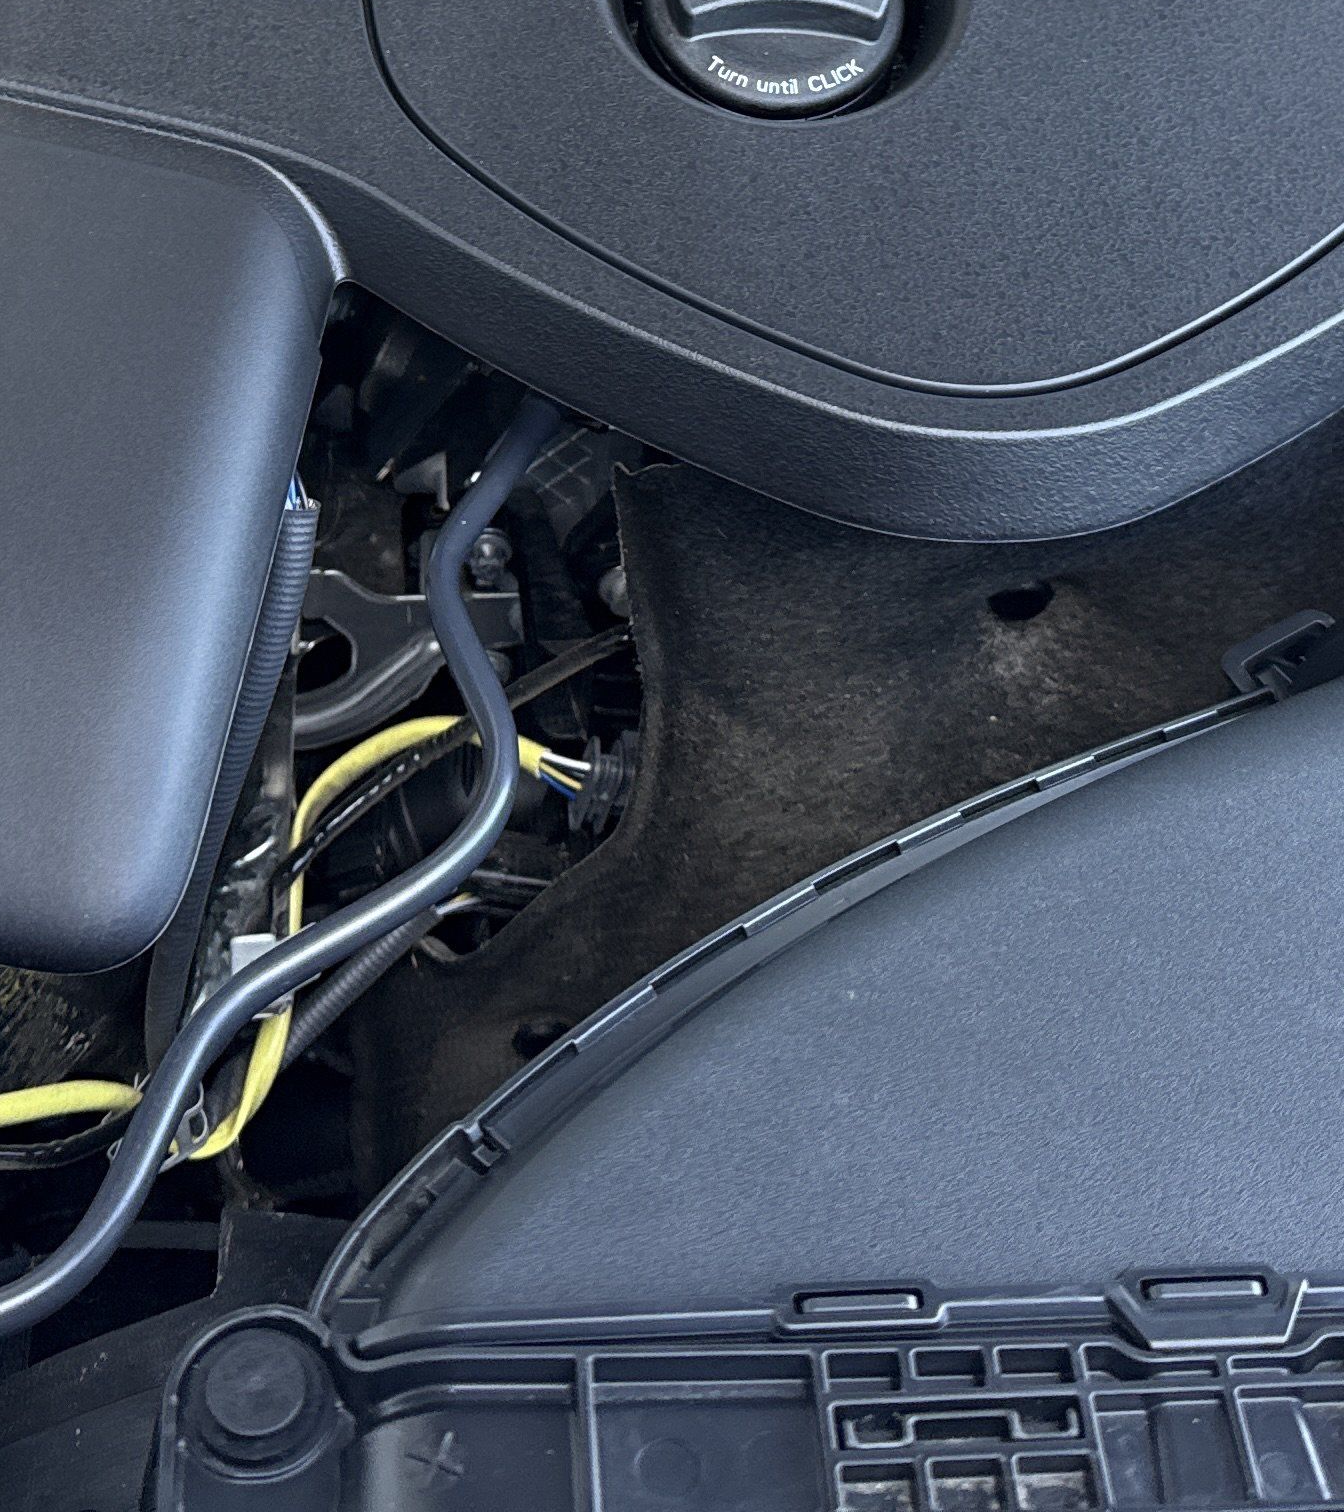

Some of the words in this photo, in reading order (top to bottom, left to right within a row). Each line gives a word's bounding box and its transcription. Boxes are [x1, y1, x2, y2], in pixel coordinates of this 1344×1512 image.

[707, 55, 749, 88] Turn
[756, 78, 799, 95] until
[807, 58, 864, 93] CLICK
